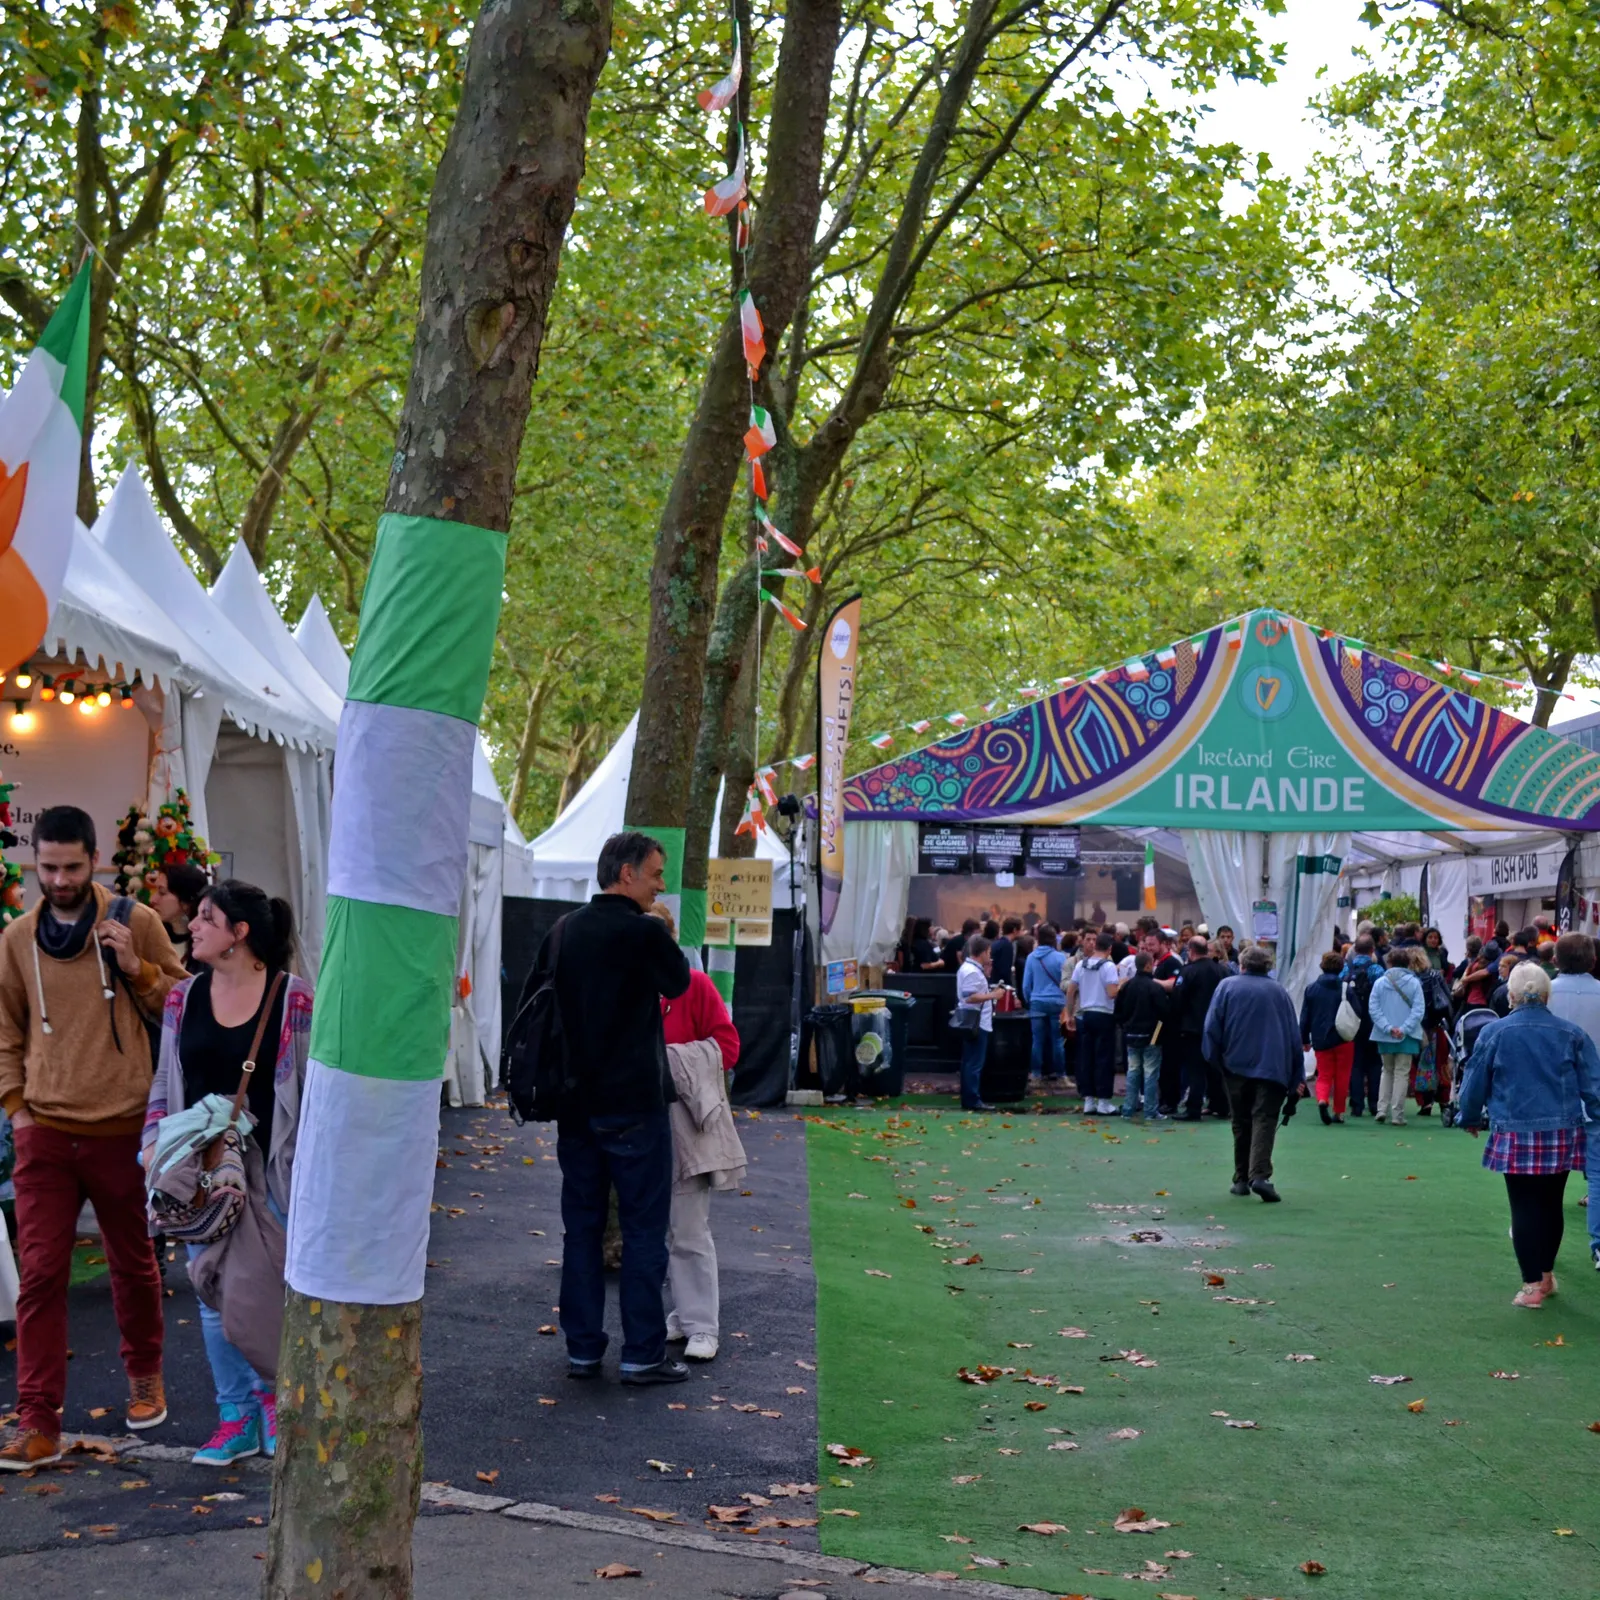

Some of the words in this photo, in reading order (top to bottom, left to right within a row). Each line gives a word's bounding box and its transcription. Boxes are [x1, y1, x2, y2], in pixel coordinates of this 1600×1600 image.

[1198, 744, 1273, 768] Ireland
[1175, 774, 1365, 812] IRLANDE
[1491, 855, 1516, 885] IRISH
[1519, 852, 1538, 881] PUB
